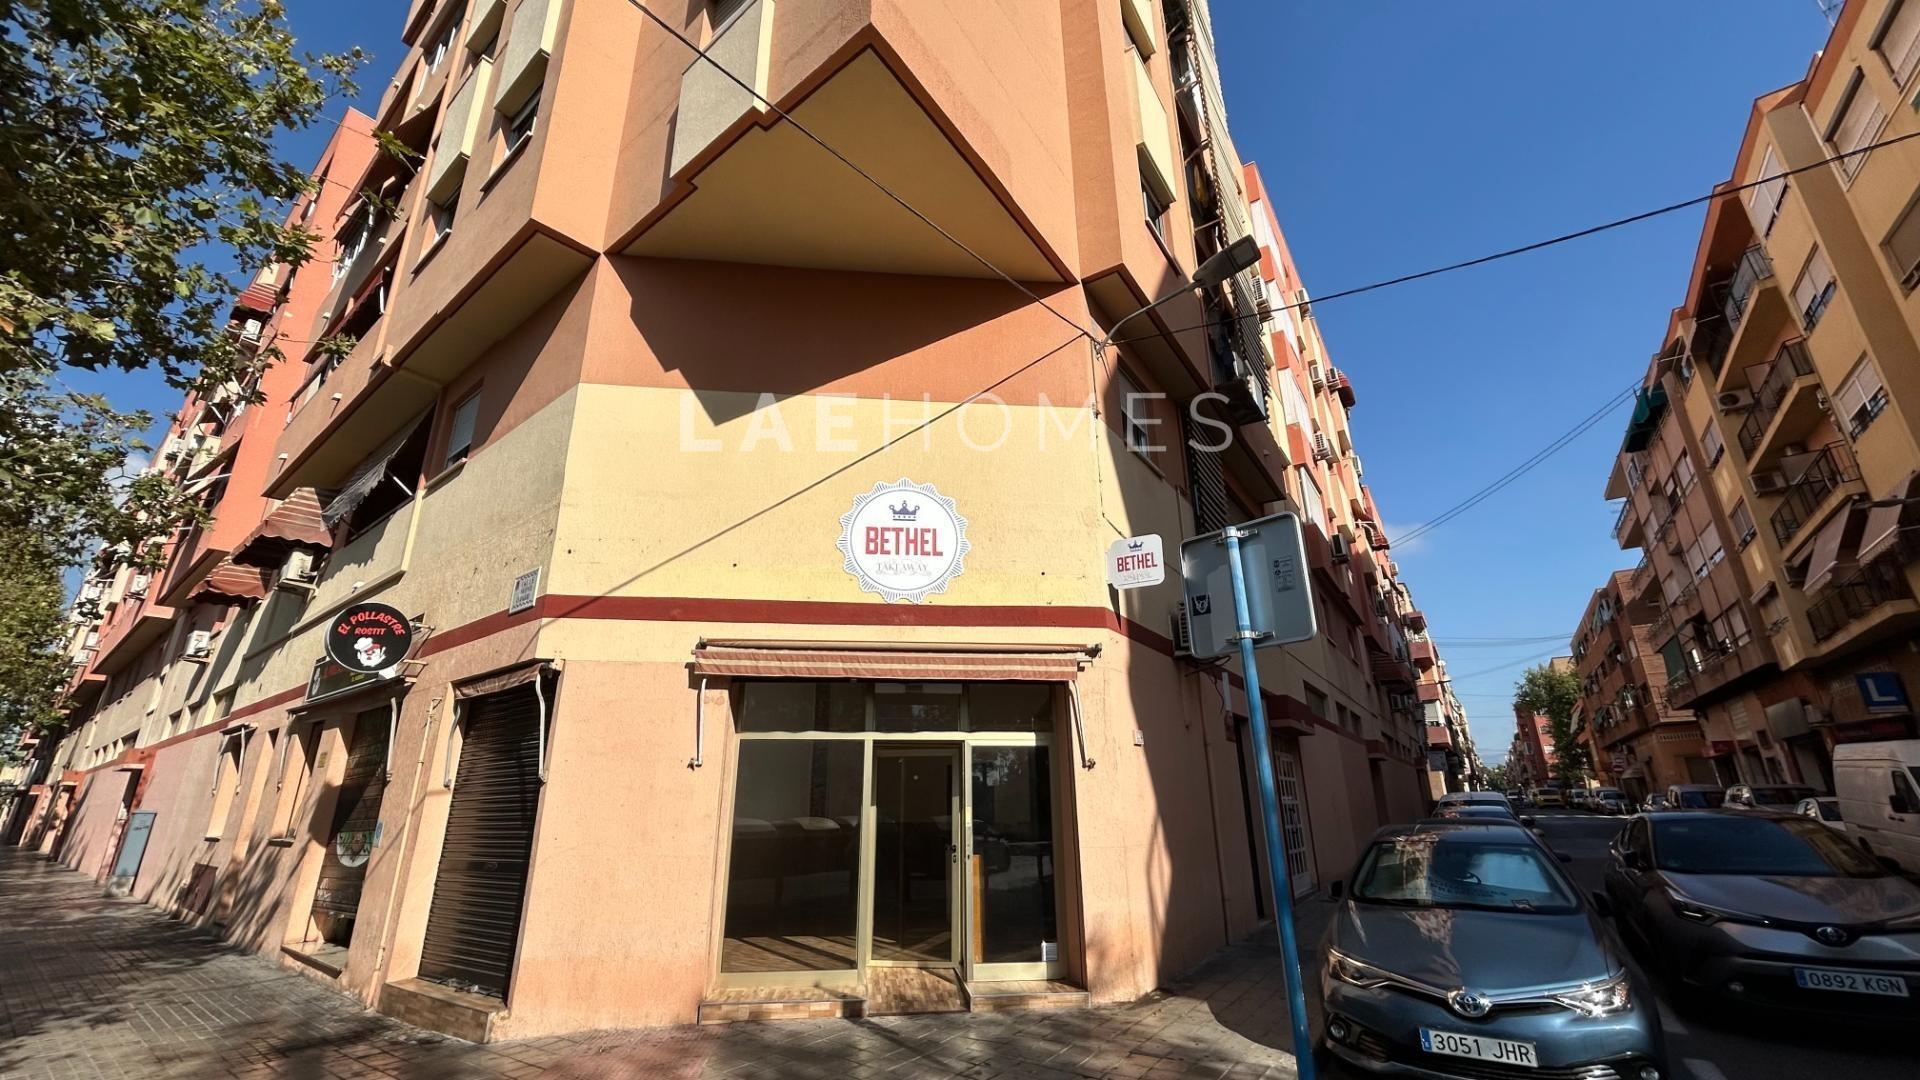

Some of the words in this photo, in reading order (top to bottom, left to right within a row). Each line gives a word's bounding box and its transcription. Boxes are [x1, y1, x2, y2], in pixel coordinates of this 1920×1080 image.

[865, 526, 943, 557] BETHEL
[1116, 552, 1158, 573] BETHEL
[337, 623, 351, 635] EL
[349, 611, 406, 636] POLLASTRE
[354, 627, 387, 635] ROSTIT
[1865, 677, 1898, 702] L
[1808, 972, 1859, 991] 0892
[1862, 976, 1903, 994] KGN
[1433, 1033, 1482, 1057] 3051
[1493, 1041, 1532, 1063] JHR
